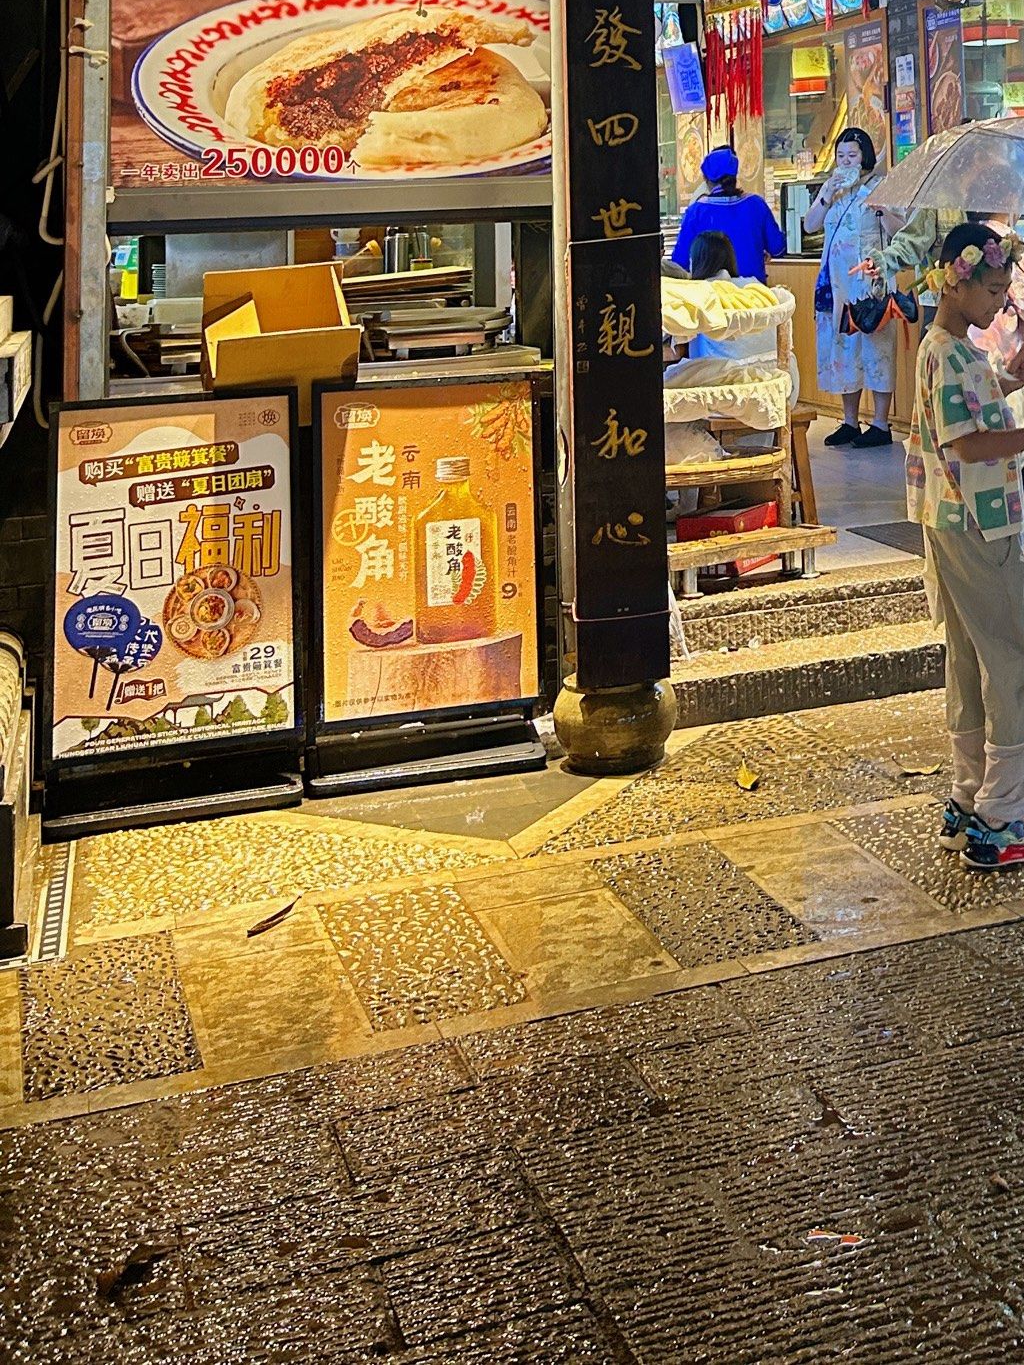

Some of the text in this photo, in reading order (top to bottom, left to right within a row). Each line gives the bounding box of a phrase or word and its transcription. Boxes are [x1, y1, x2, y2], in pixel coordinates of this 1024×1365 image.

[121, 146, 362, 181] 一年卖出250000个
[401, 444, 421, 490] 云南
[346, 439, 396, 589] 老酸角
[66, 504, 281, 597] 夏日福利
[445, 524, 463, 576] 老酸角
[501, 582, 518, 600] 9
[250, 645, 275, 660] 29
